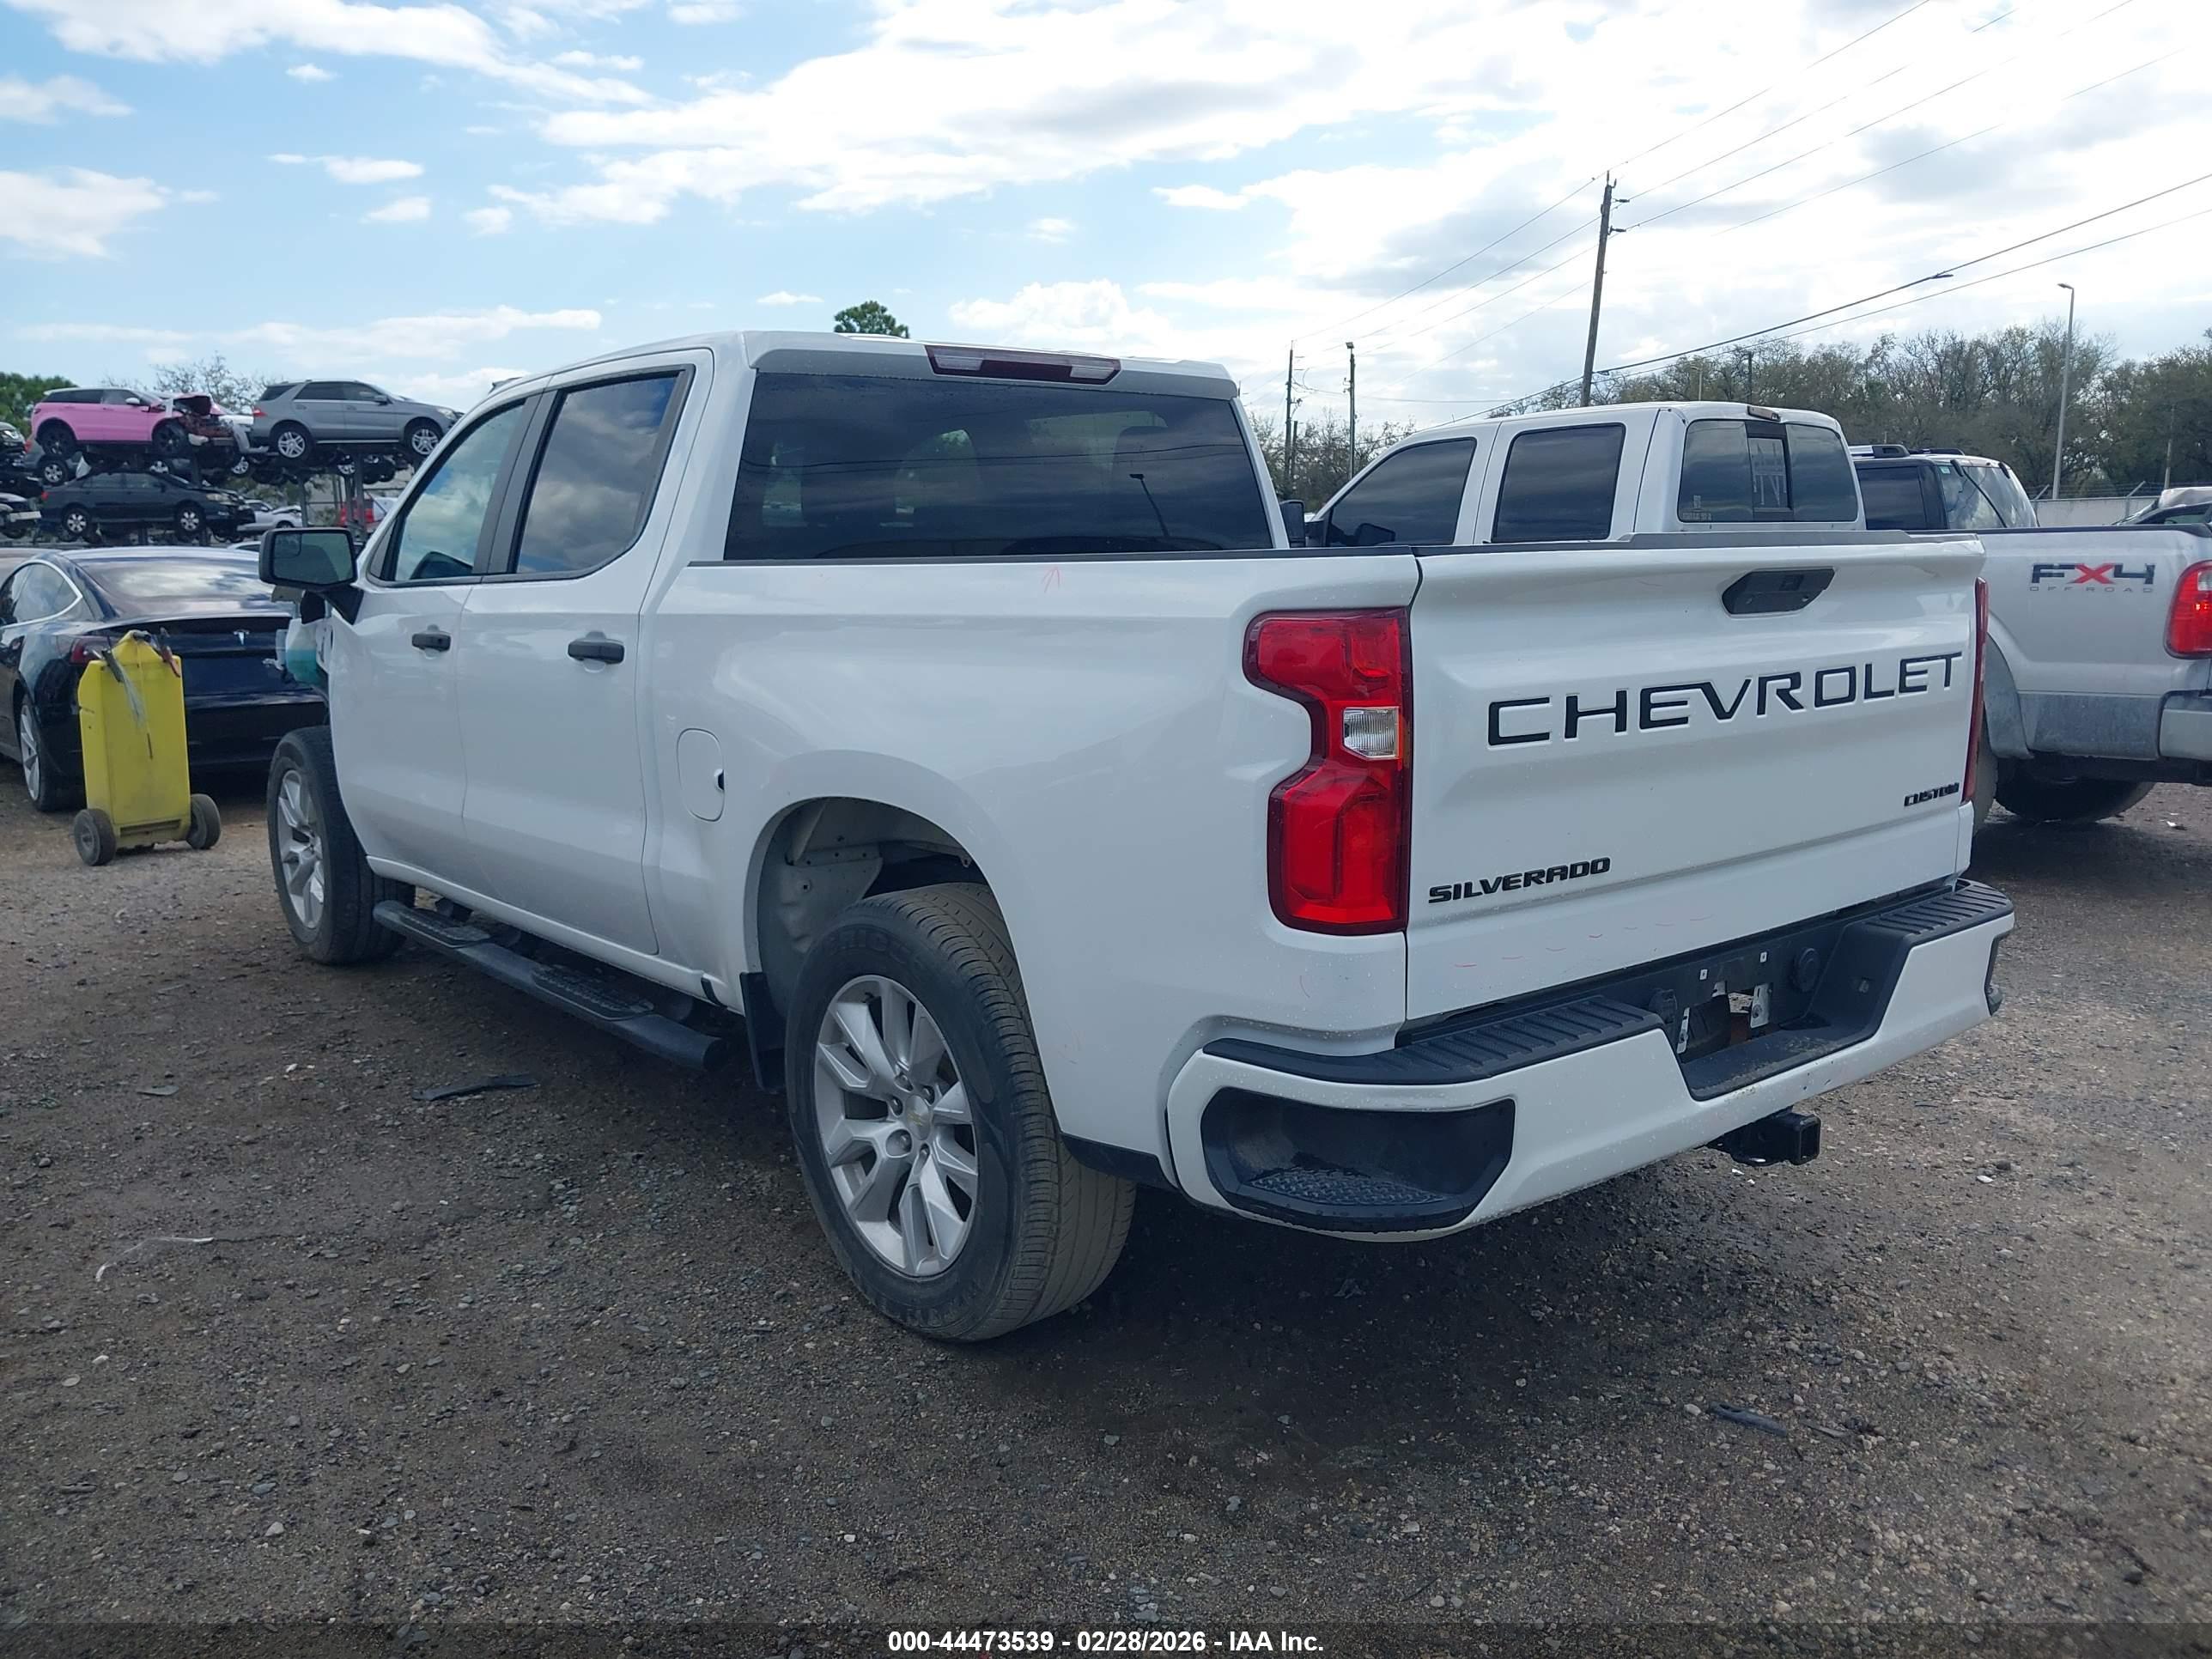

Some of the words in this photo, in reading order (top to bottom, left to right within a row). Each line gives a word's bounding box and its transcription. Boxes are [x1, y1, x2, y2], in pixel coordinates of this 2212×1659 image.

[2031, 563, 2155, 584] FX4
[1488, 652, 1962, 746] CHEVROLET
[1428, 857, 1610, 903] SILVERADO
